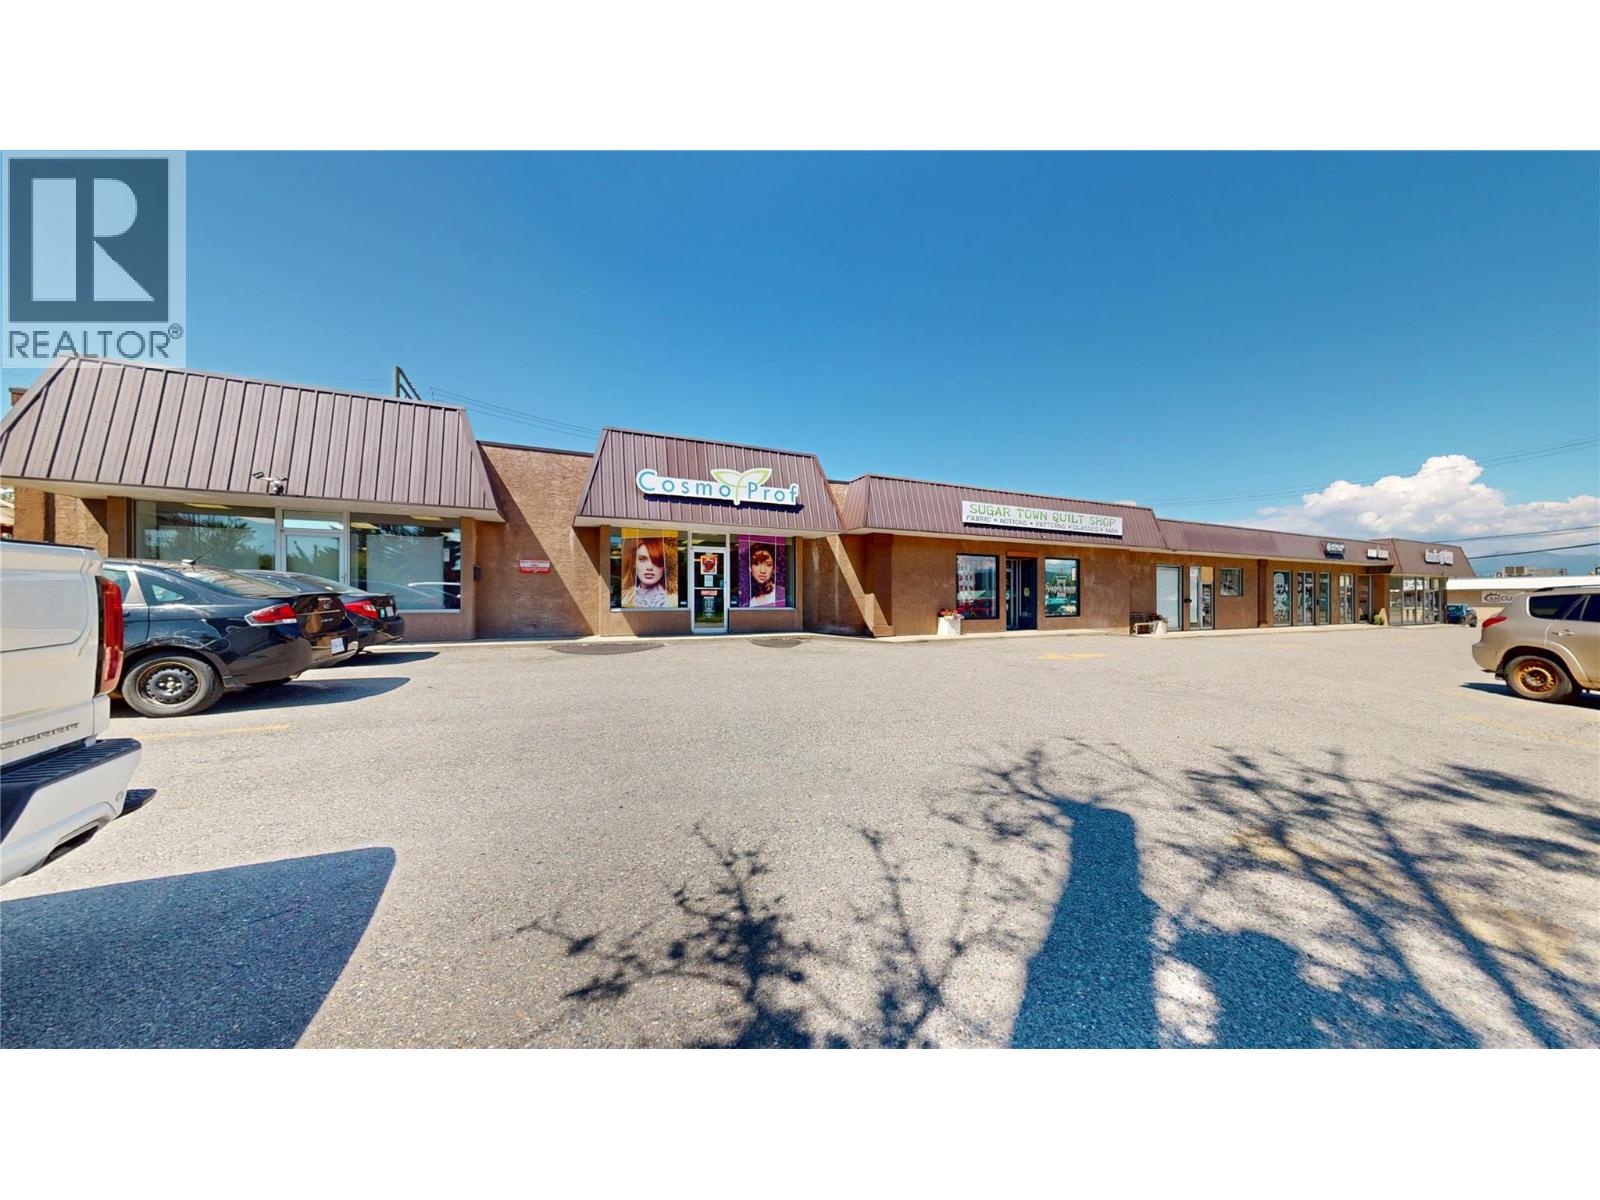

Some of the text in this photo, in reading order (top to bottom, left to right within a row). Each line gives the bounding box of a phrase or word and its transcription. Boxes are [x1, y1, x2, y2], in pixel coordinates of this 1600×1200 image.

[638, 470, 798, 502] Cosmo Prof
[966, 515, 992, 523] FABRIC
[999, 518, 1029, 526] NOTIONS
[969, 503, 1115, 527] SUGAR TOWN QUILT SHOP
